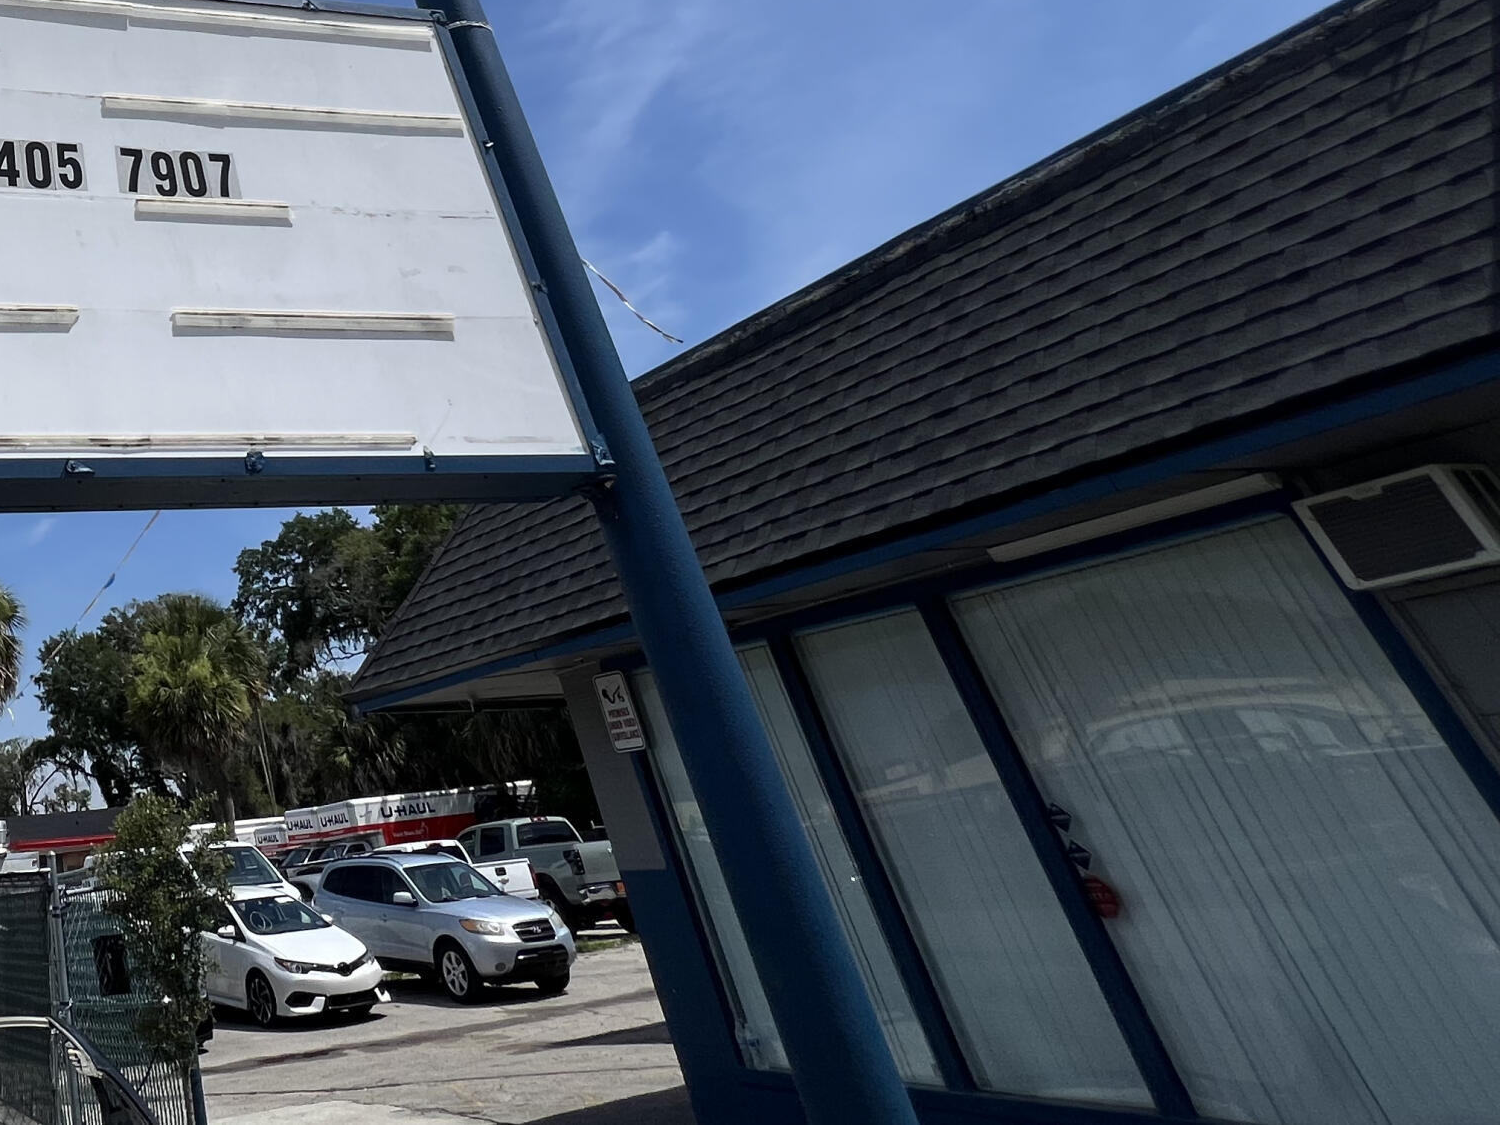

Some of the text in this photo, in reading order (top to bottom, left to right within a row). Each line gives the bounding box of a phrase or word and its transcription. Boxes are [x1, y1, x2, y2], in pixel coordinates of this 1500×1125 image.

[118, 146, 233, 198] 7907
[380, 801, 436, 819] U-HAUL
[286, 818, 314, 831] U-HAUL
[320, 812, 349, 827] U-HAUL
